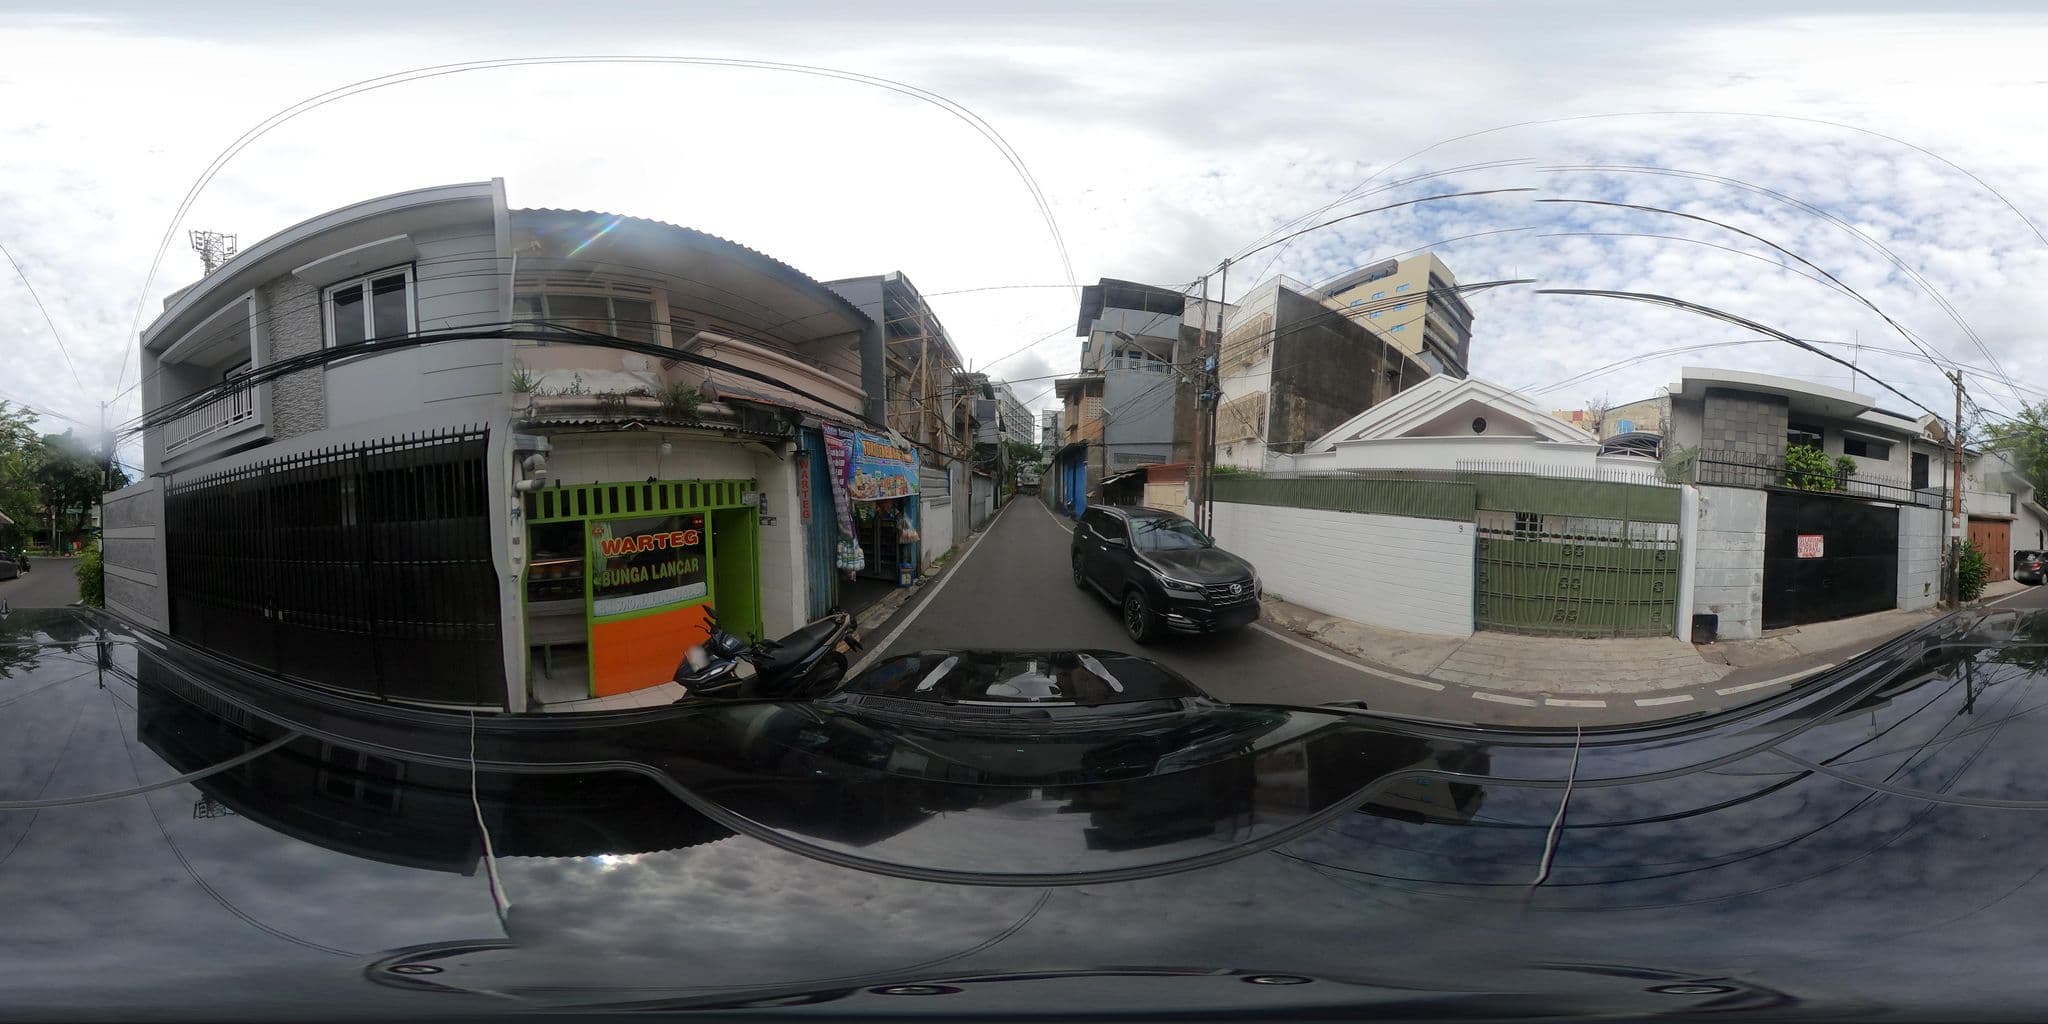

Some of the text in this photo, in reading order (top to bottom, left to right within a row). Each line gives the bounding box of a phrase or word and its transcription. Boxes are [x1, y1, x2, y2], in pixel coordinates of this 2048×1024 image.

[800, 460, 810, 519] WARTEG
[600, 529, 699, 557] WARTEG
[602, 558, 699, 587] BUNGA LANCAR
